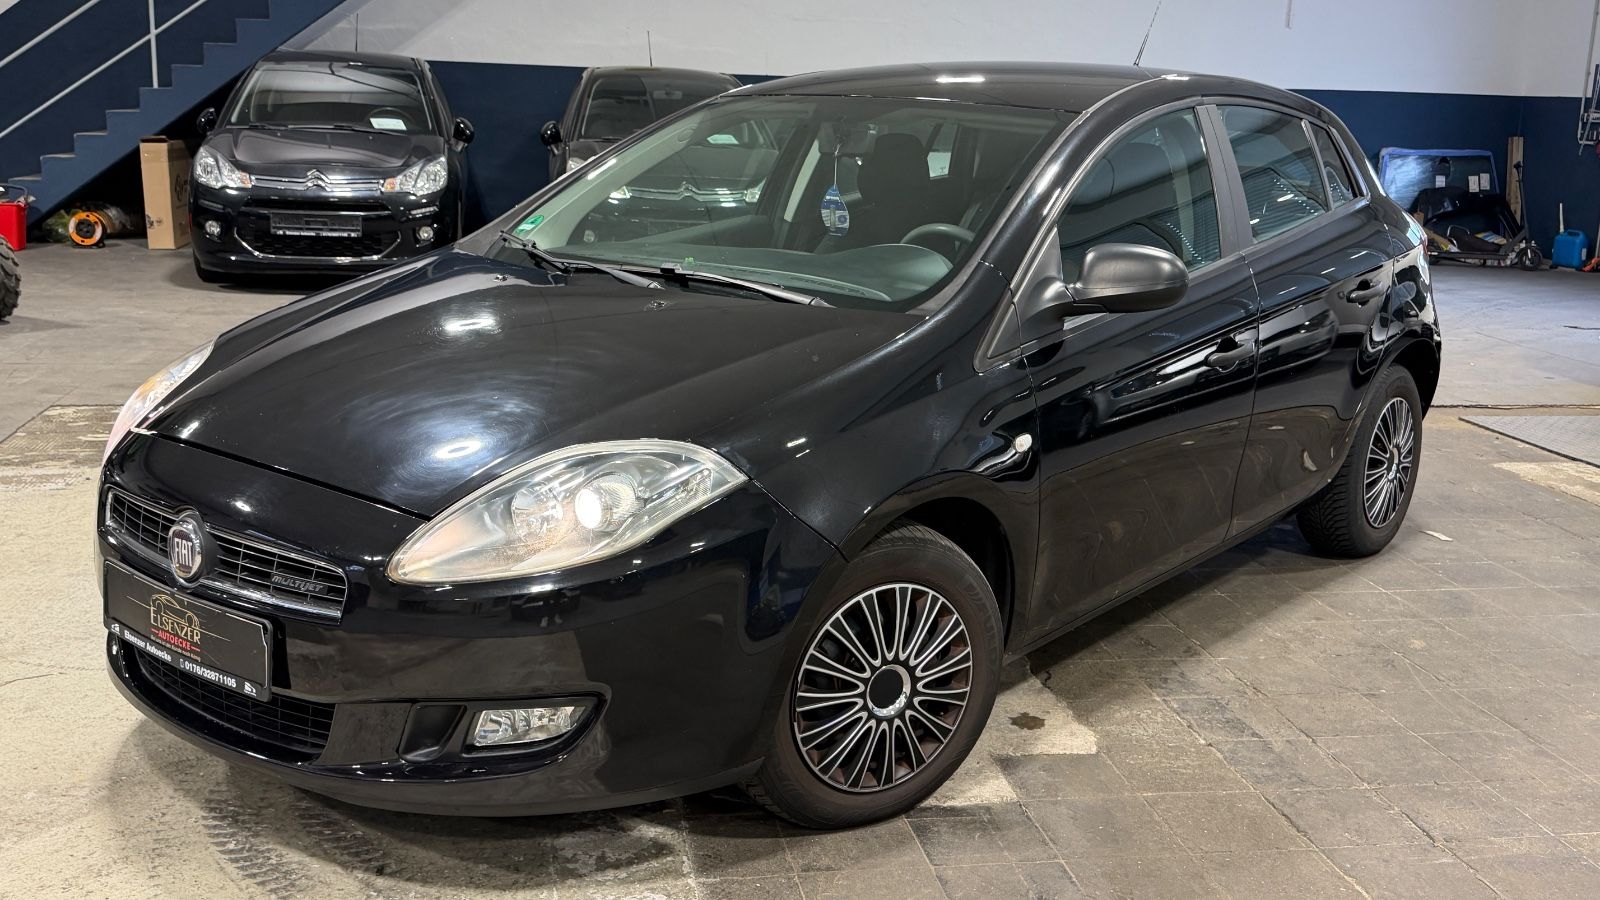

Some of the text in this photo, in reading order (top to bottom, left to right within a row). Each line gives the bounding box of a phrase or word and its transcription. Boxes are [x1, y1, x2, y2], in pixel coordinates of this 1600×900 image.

[174, 537, 193, 567] FIAT
[272, 575, 323, 591] MULTIJET
[151, 606, 201, 645] ELSENZER
[158, 630, 191, 650] AUTOECKE
